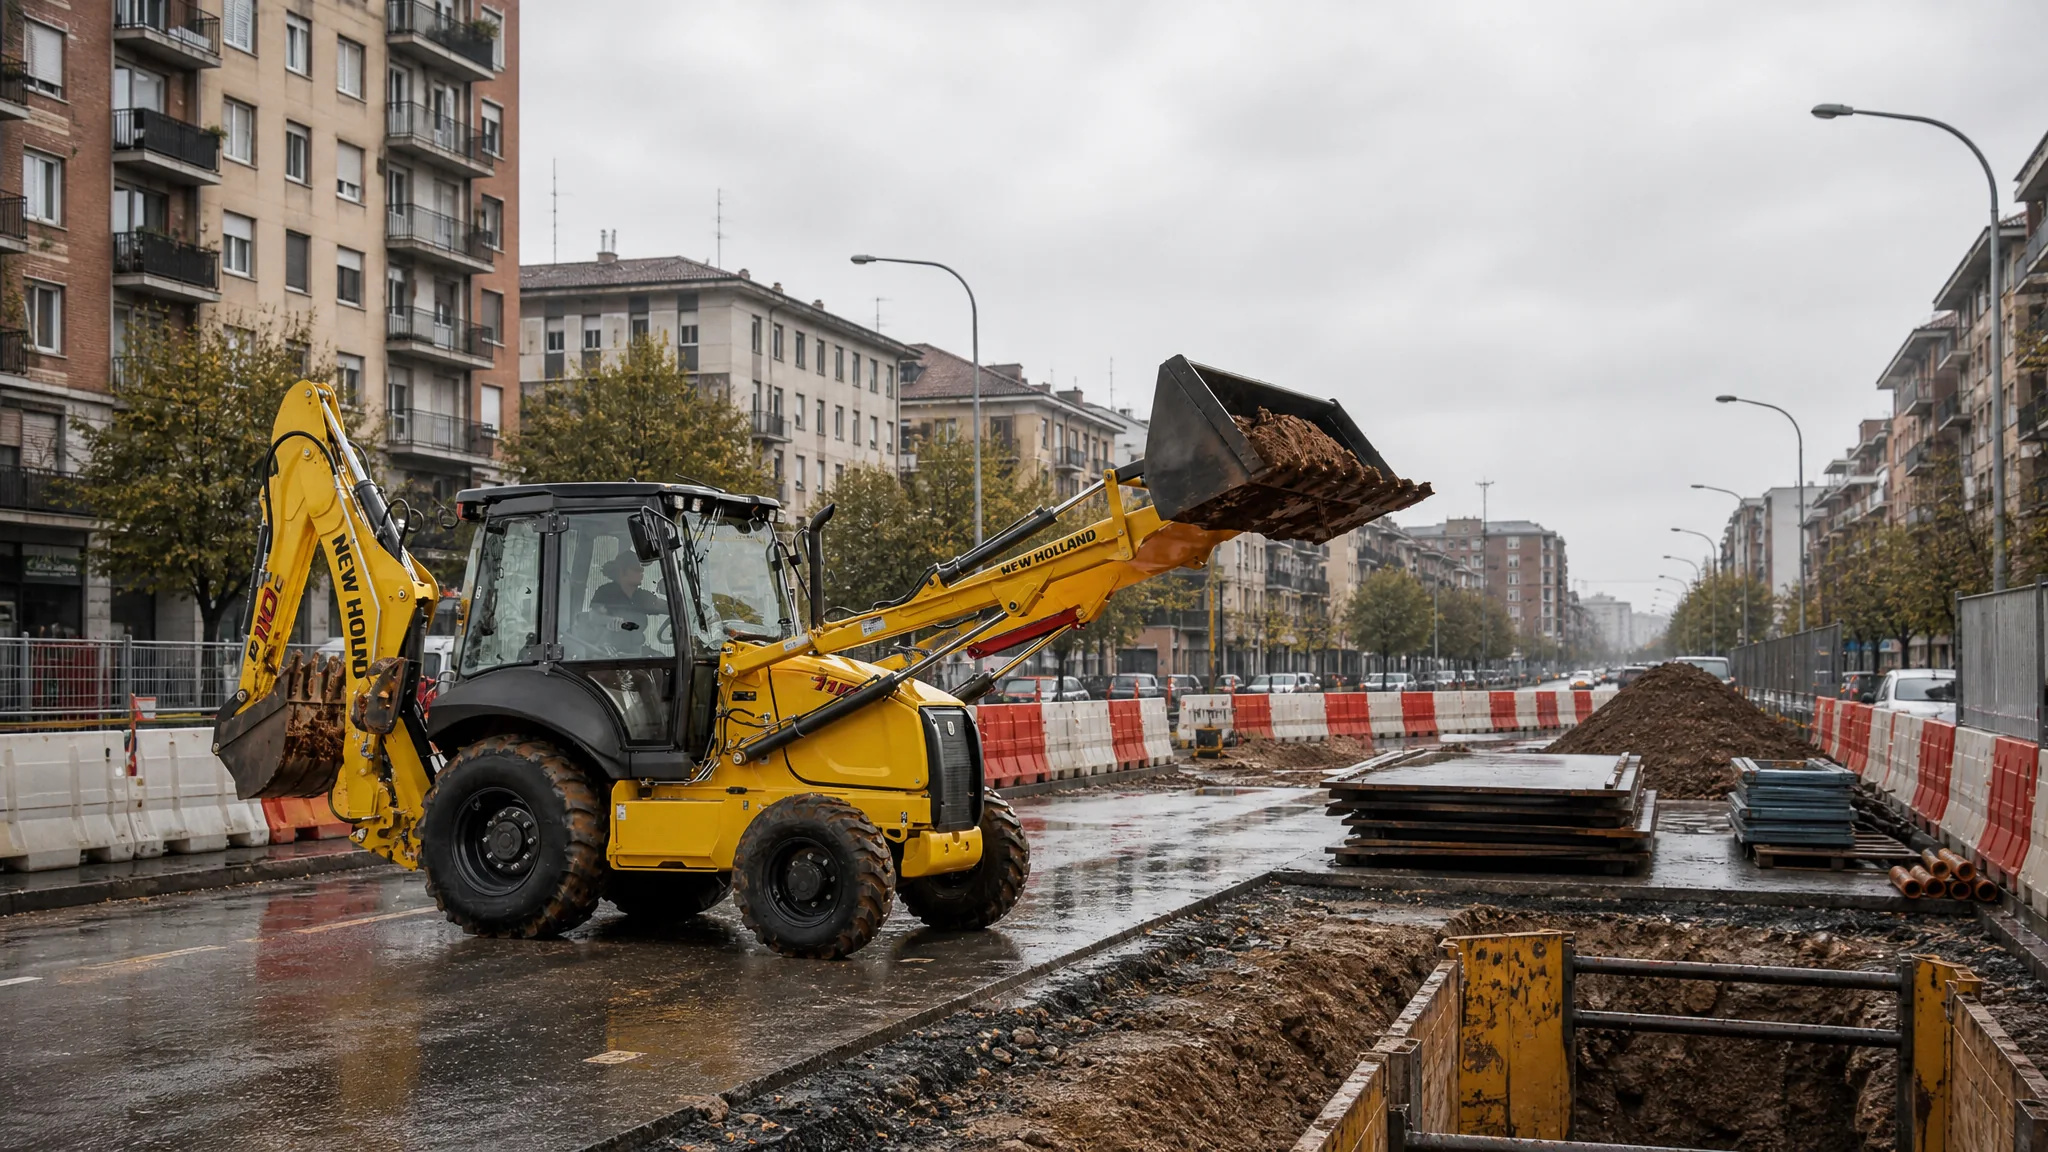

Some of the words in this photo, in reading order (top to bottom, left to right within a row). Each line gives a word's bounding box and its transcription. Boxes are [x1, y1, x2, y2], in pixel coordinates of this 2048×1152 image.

[332, 533, 359, 592] NEW
[1001, 556, 1032, 575] NEW
[1034, 529, 1096, 563] HOLLAND
